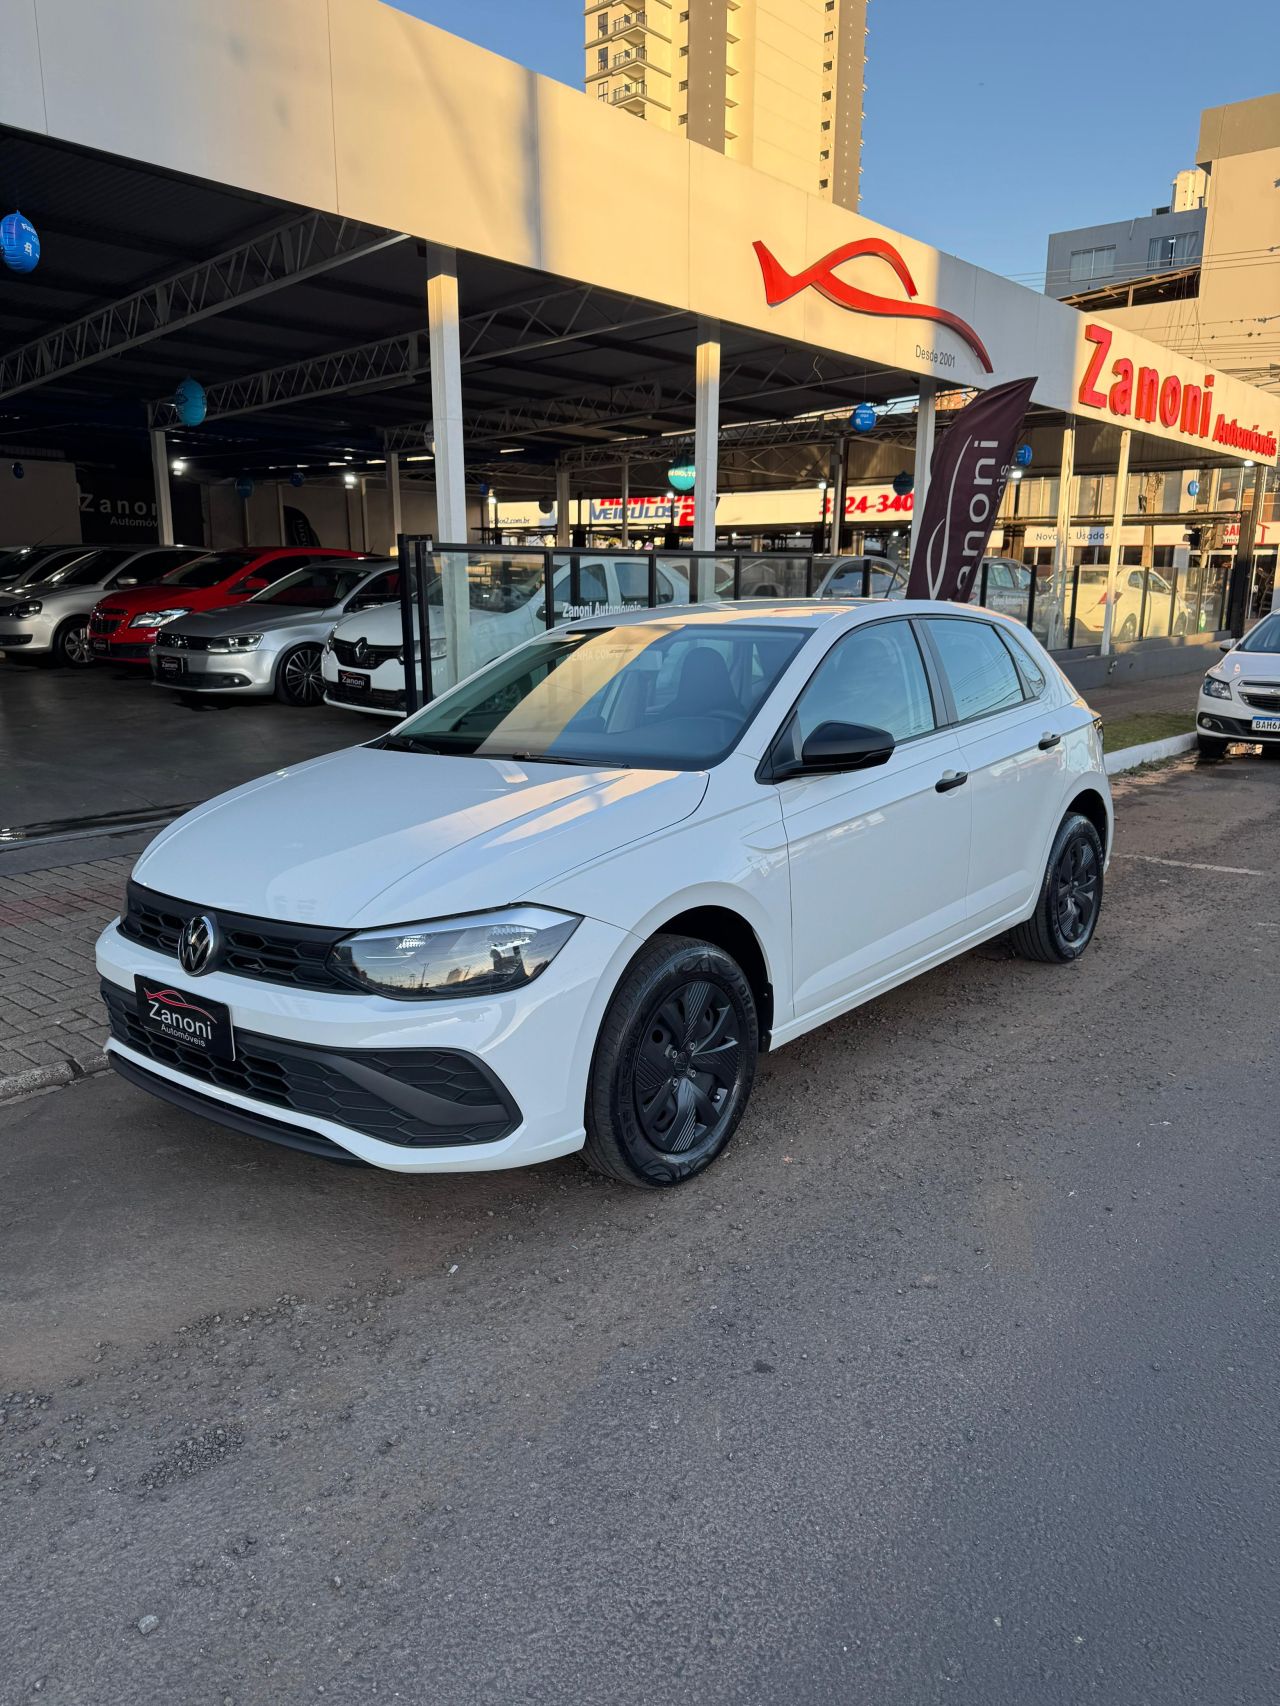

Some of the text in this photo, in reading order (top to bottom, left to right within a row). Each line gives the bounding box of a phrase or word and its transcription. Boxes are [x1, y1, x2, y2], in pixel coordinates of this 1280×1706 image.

[915, 345, 956, 368] Desde 2001
[1078, 324, 1277, 457] Zanoni Automóveis
[562, 602, 593, 618] Zanoni
[147, 1000, 212, 1040] Zanoni
[160, 1023, 206, 1047] Automóveis
